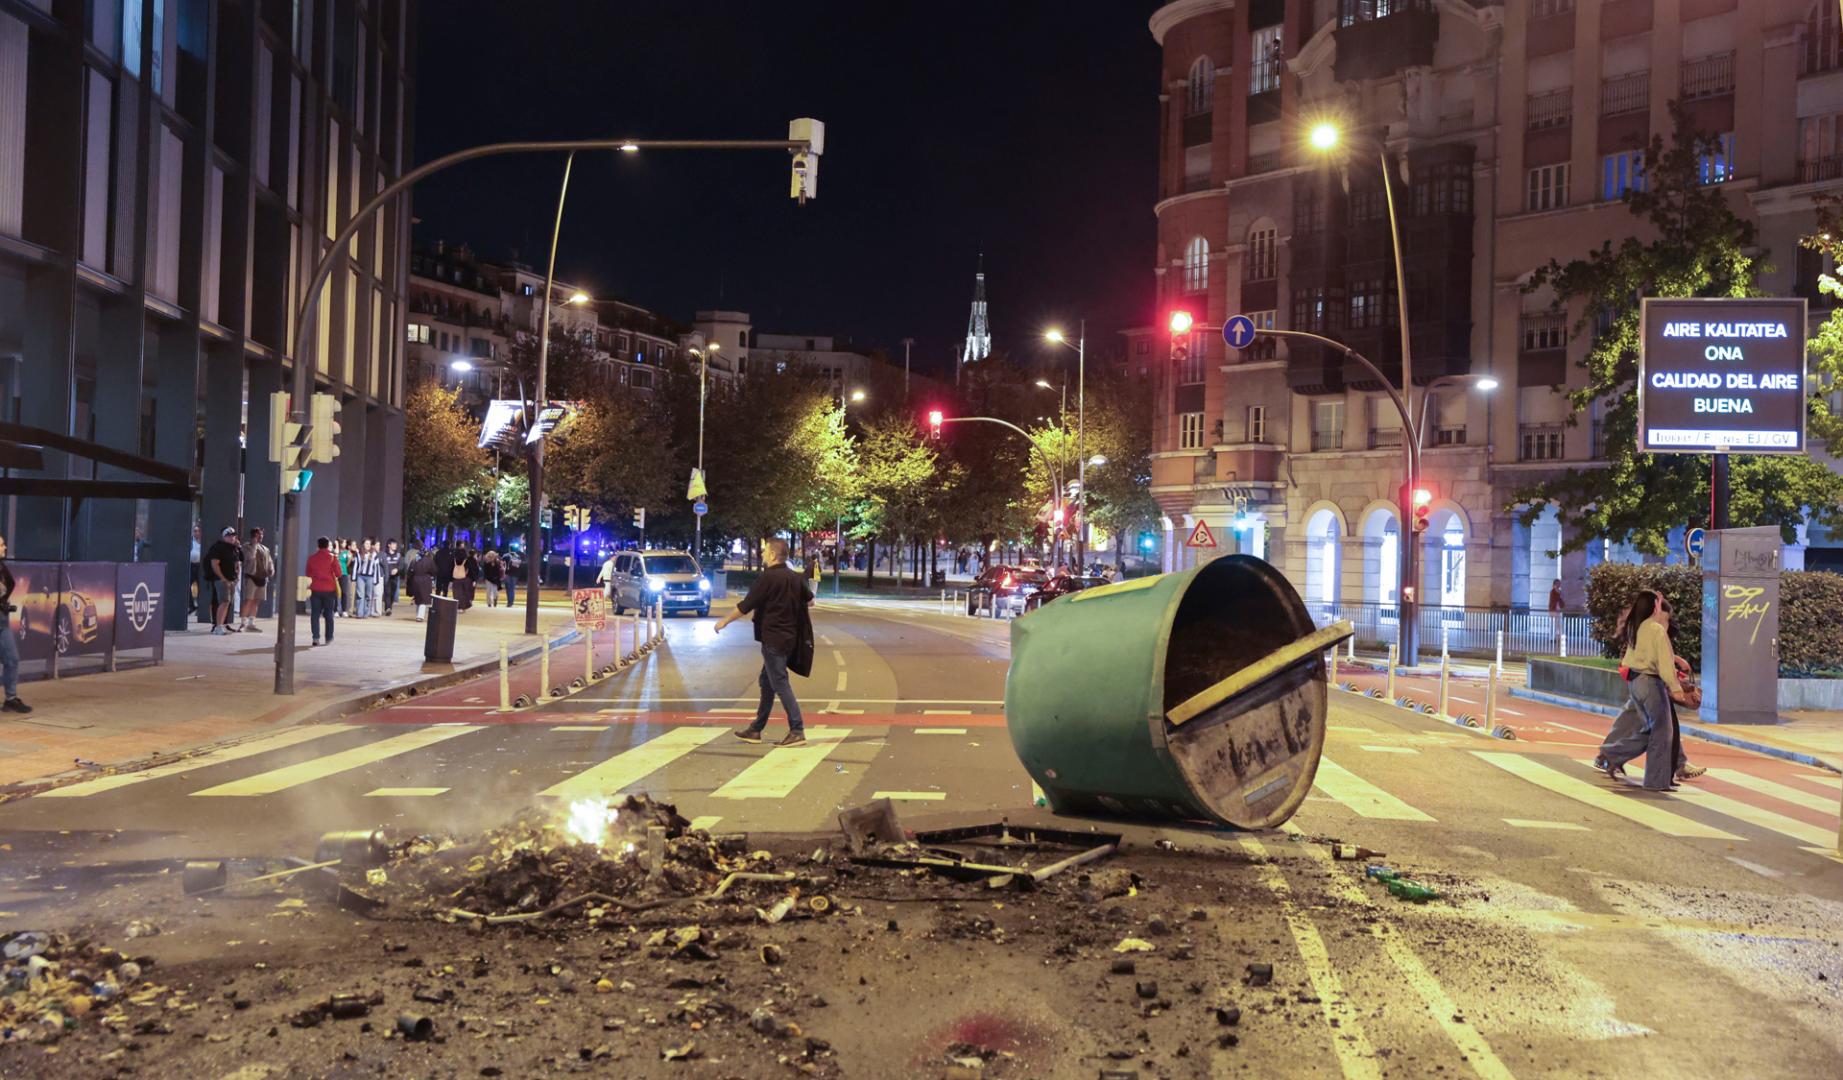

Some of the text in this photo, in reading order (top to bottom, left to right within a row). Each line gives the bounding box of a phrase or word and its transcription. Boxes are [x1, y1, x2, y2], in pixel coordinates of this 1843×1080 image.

[1663, 322, 1788, 338] AIRE KALITATEA
[1704, 346, 1744, 361] ONA
[1652, 373, 1798, 390] CALIDAD DEL AIRE
[1694, 398, 1753, 414] BUENA
[134, 600, 148, 613] MINI
